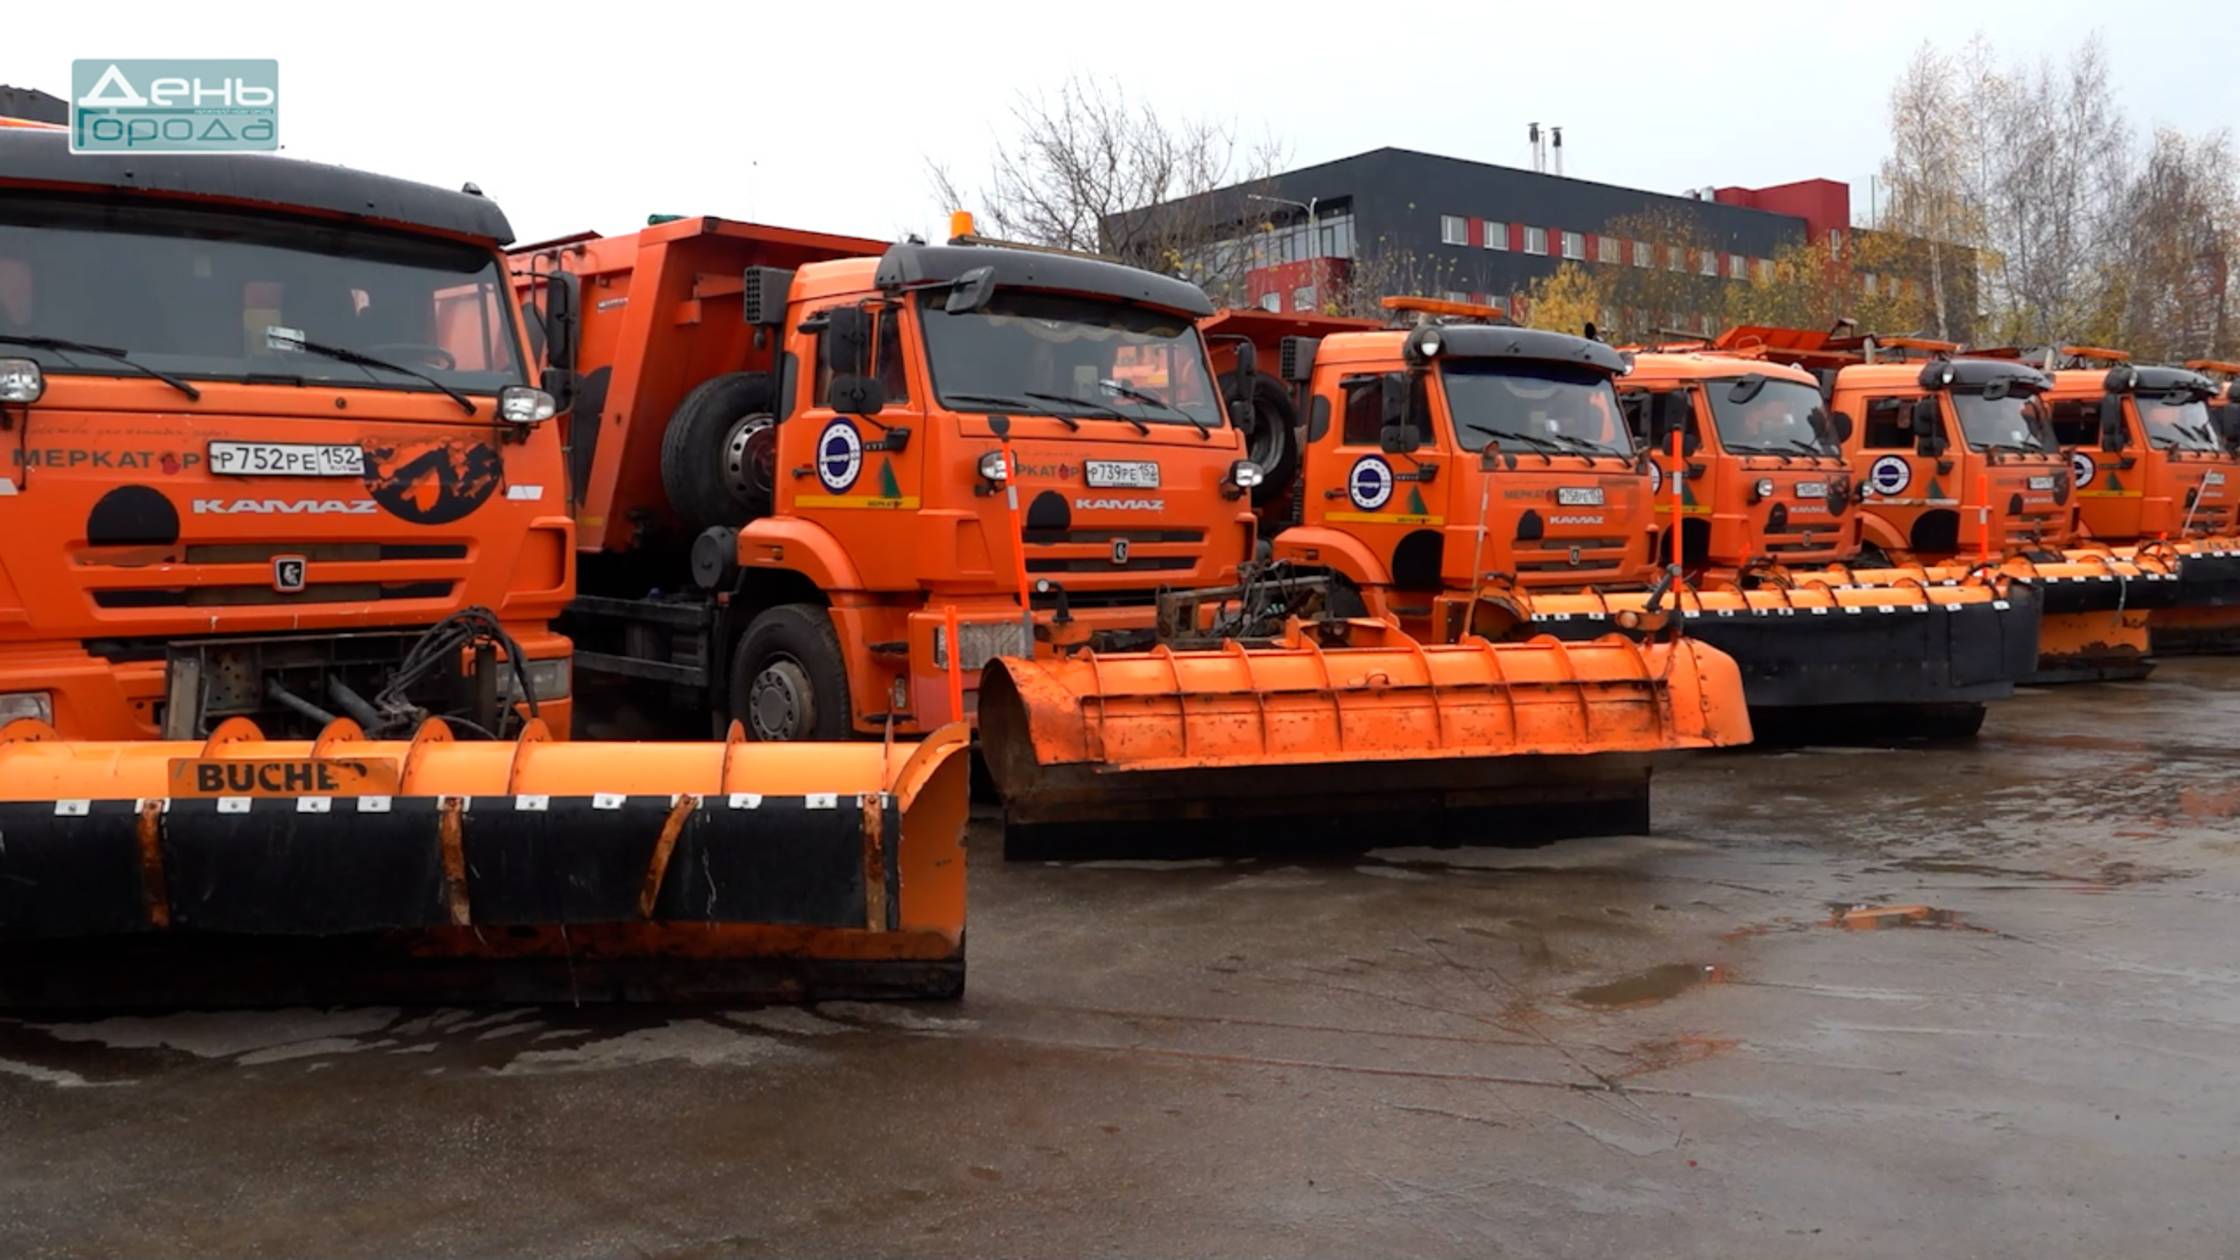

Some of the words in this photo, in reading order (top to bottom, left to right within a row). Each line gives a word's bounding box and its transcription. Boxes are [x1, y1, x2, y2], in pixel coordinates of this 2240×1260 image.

[321, 448, 356, 466] 152
[193, 500, 378, 514] KAMAZ
[1075, 499, 1165, 510] KAMAZ
